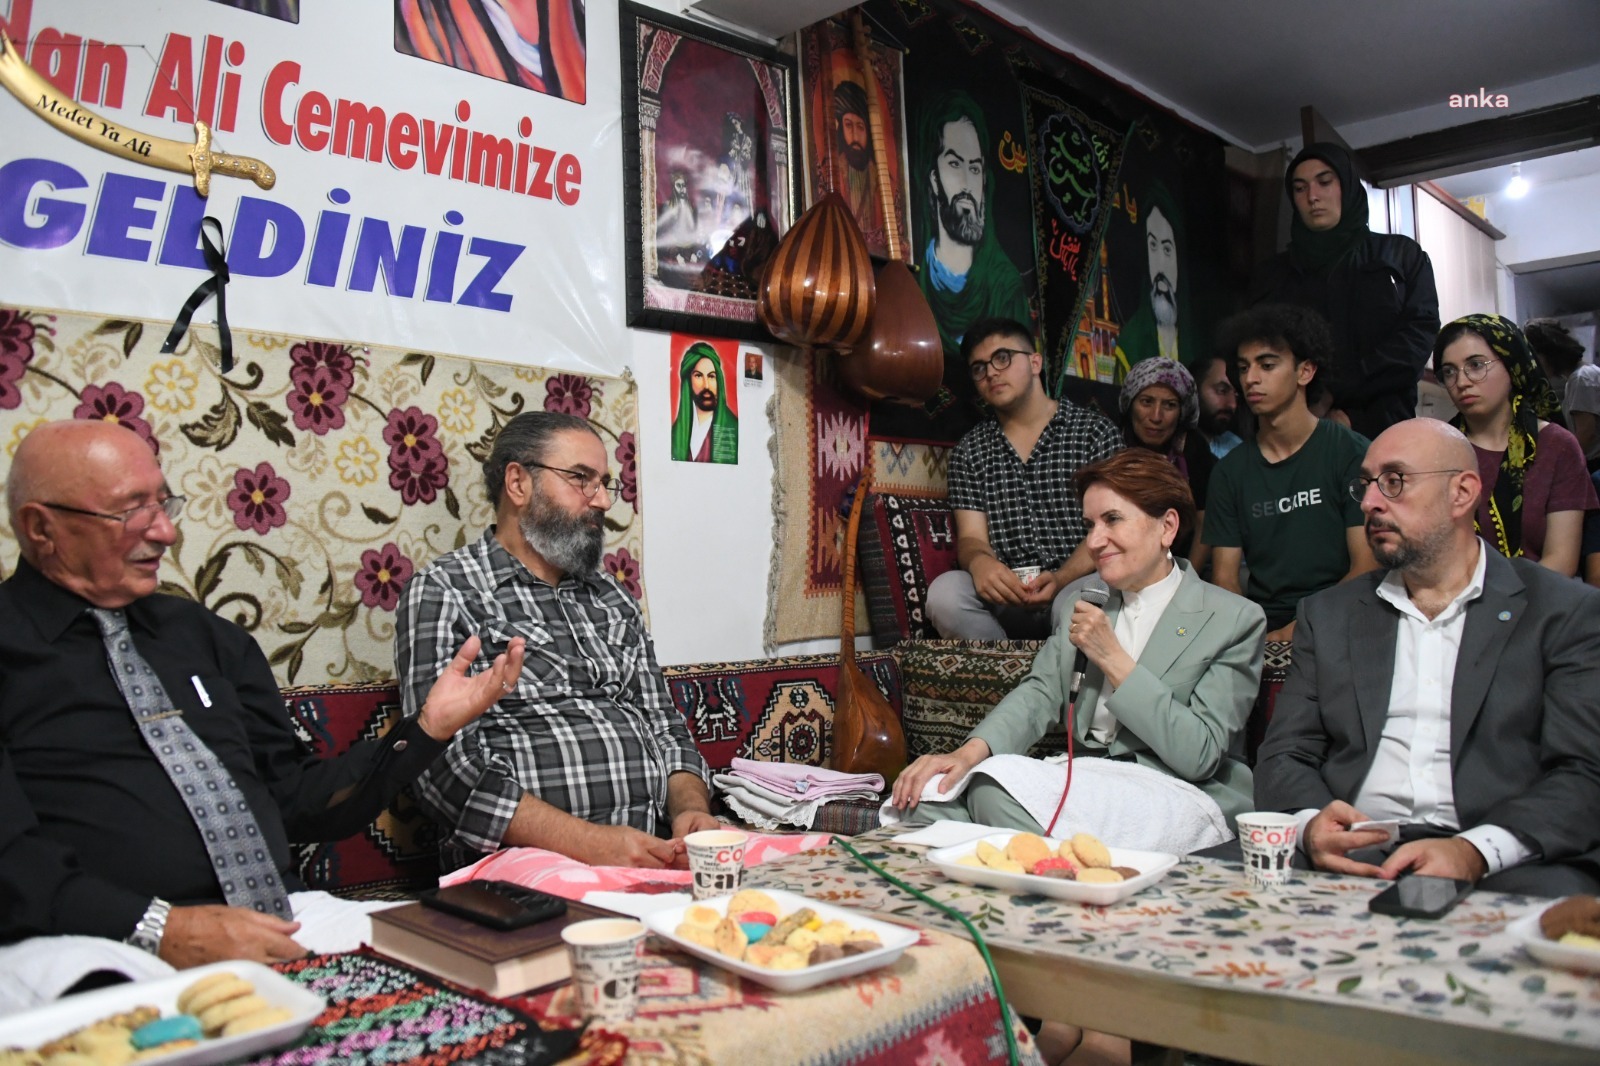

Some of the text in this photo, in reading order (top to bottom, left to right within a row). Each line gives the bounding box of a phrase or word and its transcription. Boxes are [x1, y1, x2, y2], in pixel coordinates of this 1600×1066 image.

[37, 94, 152, 158] Medet Ya Ali
[144, 33, 246, 133] Ali
[261, 61, 582, 206] Cemevimize
[0, 157, 526, 313] GELDİNİZ
